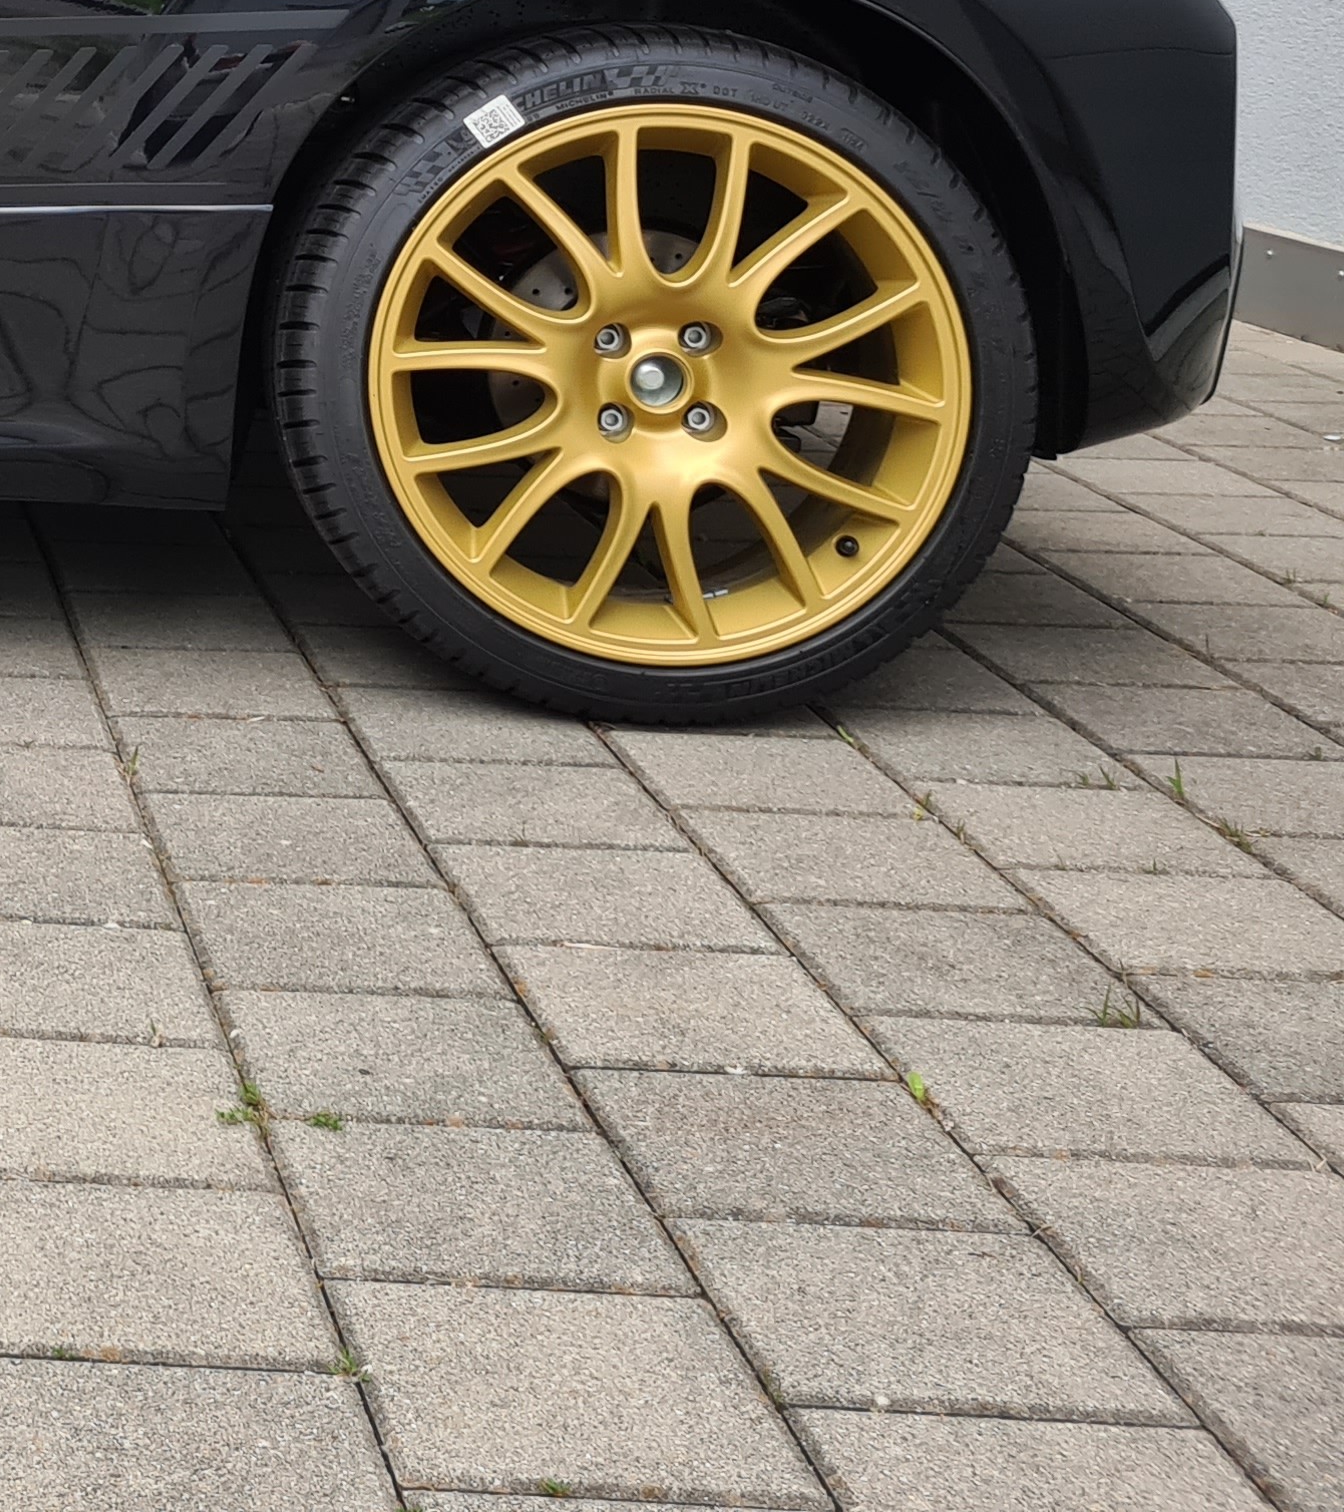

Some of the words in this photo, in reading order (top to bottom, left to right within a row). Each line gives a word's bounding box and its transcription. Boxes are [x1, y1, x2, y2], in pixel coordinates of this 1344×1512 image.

[512, 72, 605, 111] CHELIN
[634, 87, 675, 96] RADIAL
[713, 85, 738, 98] DOT
